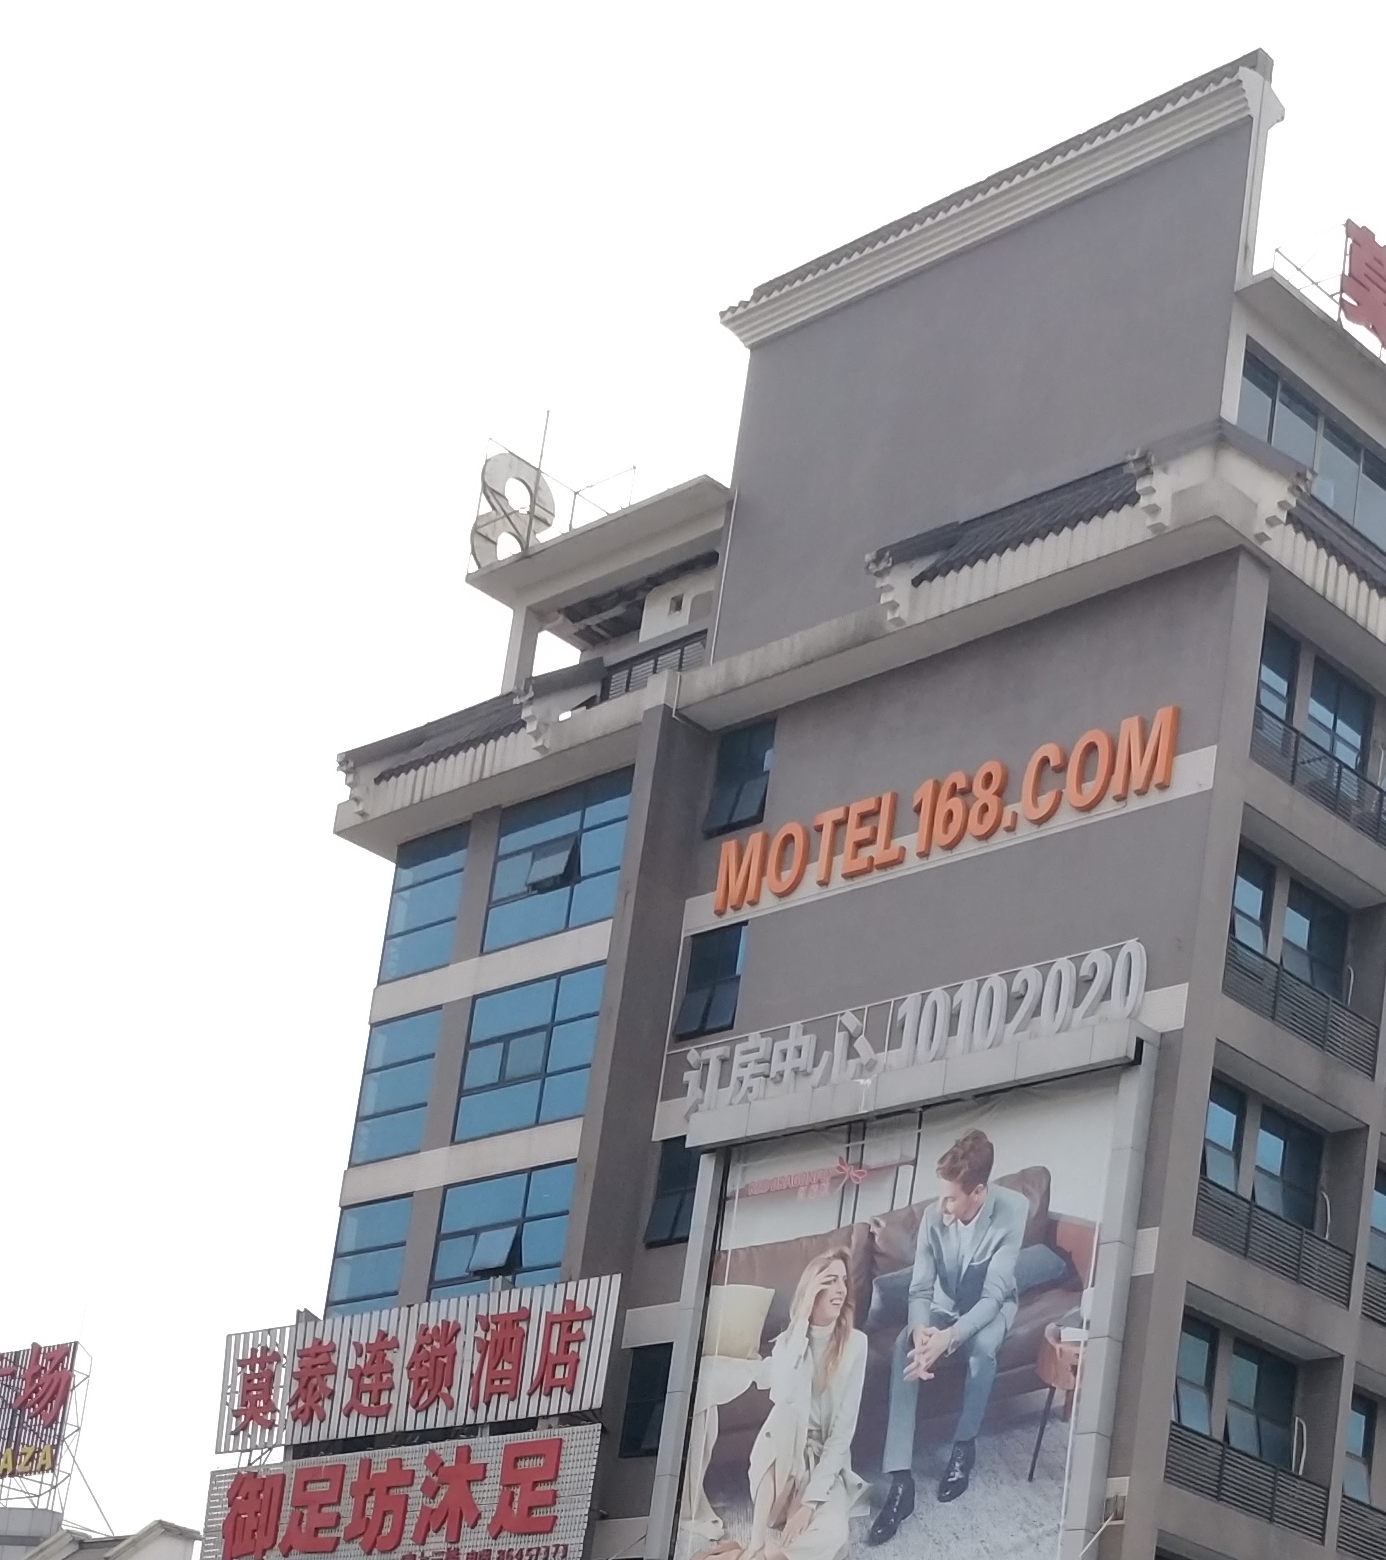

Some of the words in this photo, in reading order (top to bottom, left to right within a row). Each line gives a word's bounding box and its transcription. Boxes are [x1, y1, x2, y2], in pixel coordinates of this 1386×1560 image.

[683, 1010, 879, 1107] 订房中心
[897, 940, 1147, 1063] 10102020
[230, 1300, 592, 1435] 莫泰连锁酒店
